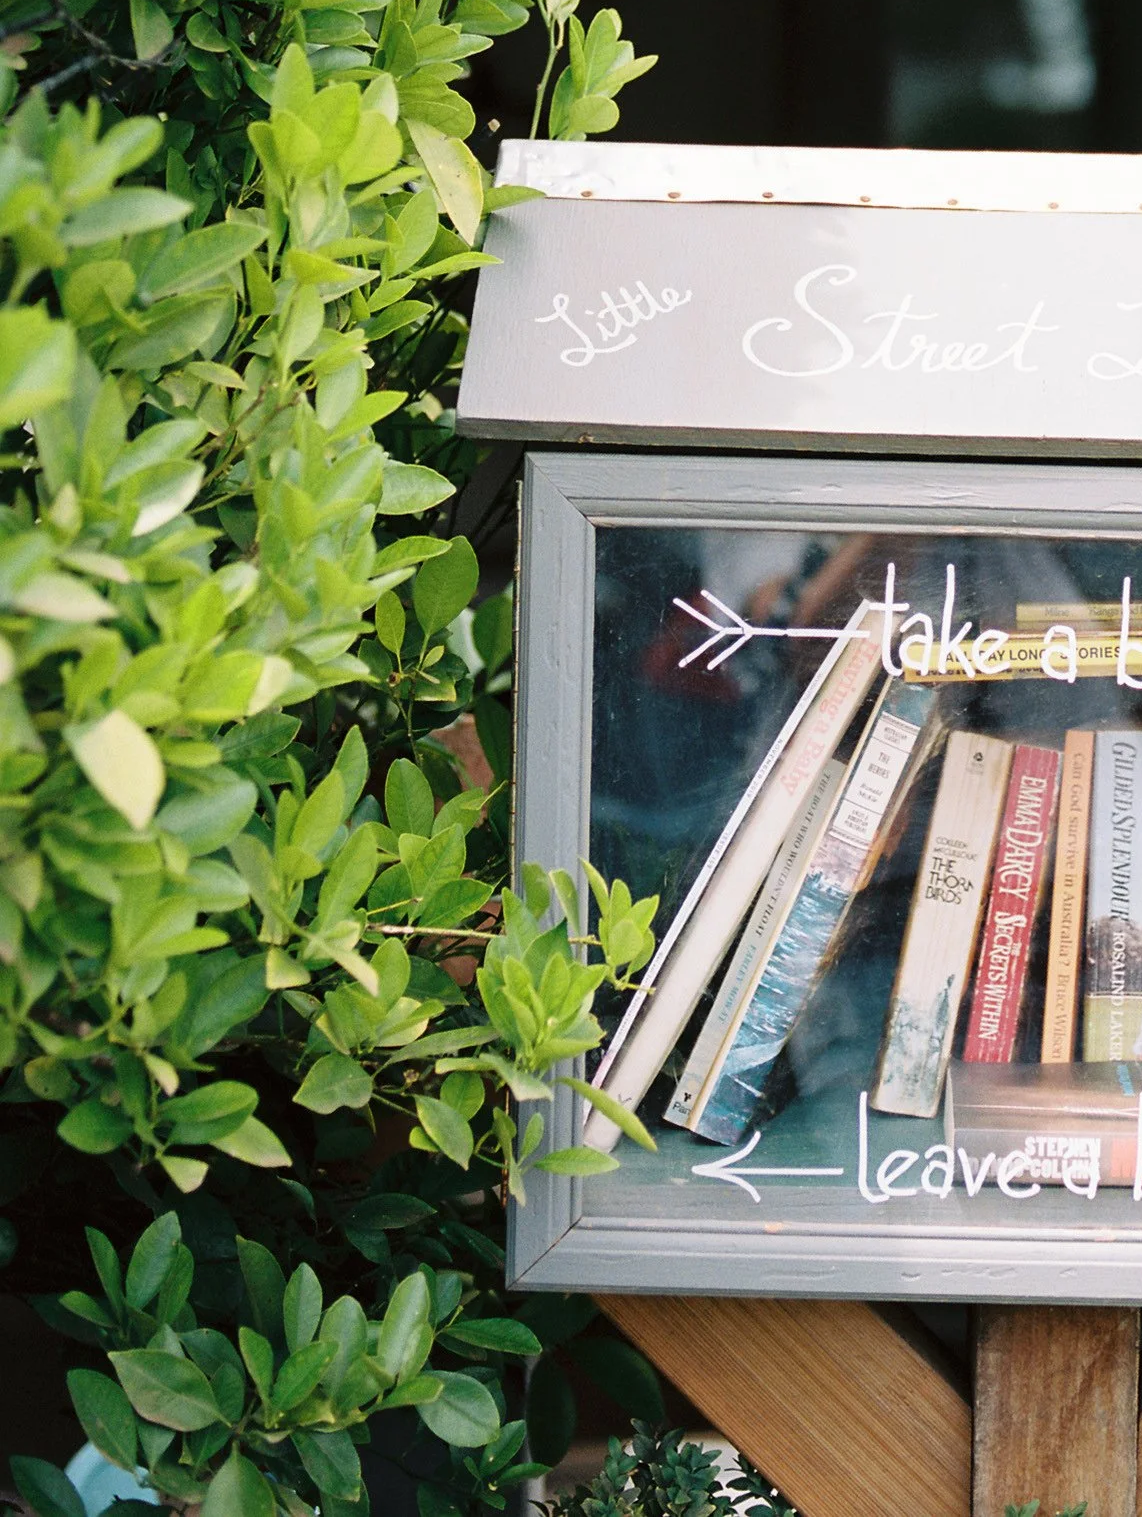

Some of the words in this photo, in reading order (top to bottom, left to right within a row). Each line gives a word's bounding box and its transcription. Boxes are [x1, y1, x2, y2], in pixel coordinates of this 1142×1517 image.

[534, 281, 692, 368] Little
[742, 263, 1059, 380] Street
[868, 562, 1011, 679] take
[1041, 624, 1078, 684] a
[820, 637, 881, 716] Having
[1057, 646, 1121, 660] ORIES
[815, 718, 832, 734] a
[780, 738, 826, 796] Baby
[817, 772, 831, 793] THE
[1072, 752, 1085, 779] Can
[1112, 741, 1137, 816] GILDED
[806, 791, 825, 820] BOAT
[1014, 775, 1047, 829] EMMA
[1070, 785, 1084, 813] God
[932, 856, 957, 874] THE
[998, 827, 1043, 902] DARCY
[1064, 816, 1080, 871] survive
[1110, 810, 1136, 923] SPLENDOUR
[925, 886, 962, 905] BIRDS
[1064, 874, 1077, 888] in
[756, 904, 775, 938] FLOAT
[988, 911, 1027, 981] SECRETS
[1058, 893, 1076, 968] Australia?
[1055, 973, 1071, 1010] Bruce
[1110, 930, 1126, 1007] ROSALIND
[978, 982, 1007, 1042] WITHIN
[1052, 1011, 1068, 1060] Wilson
[1108, 1011, 1124, 1061] LAKER
[858, 1090, 1040, 1204] leave
[1062, 1139, 1100, 1200] a
